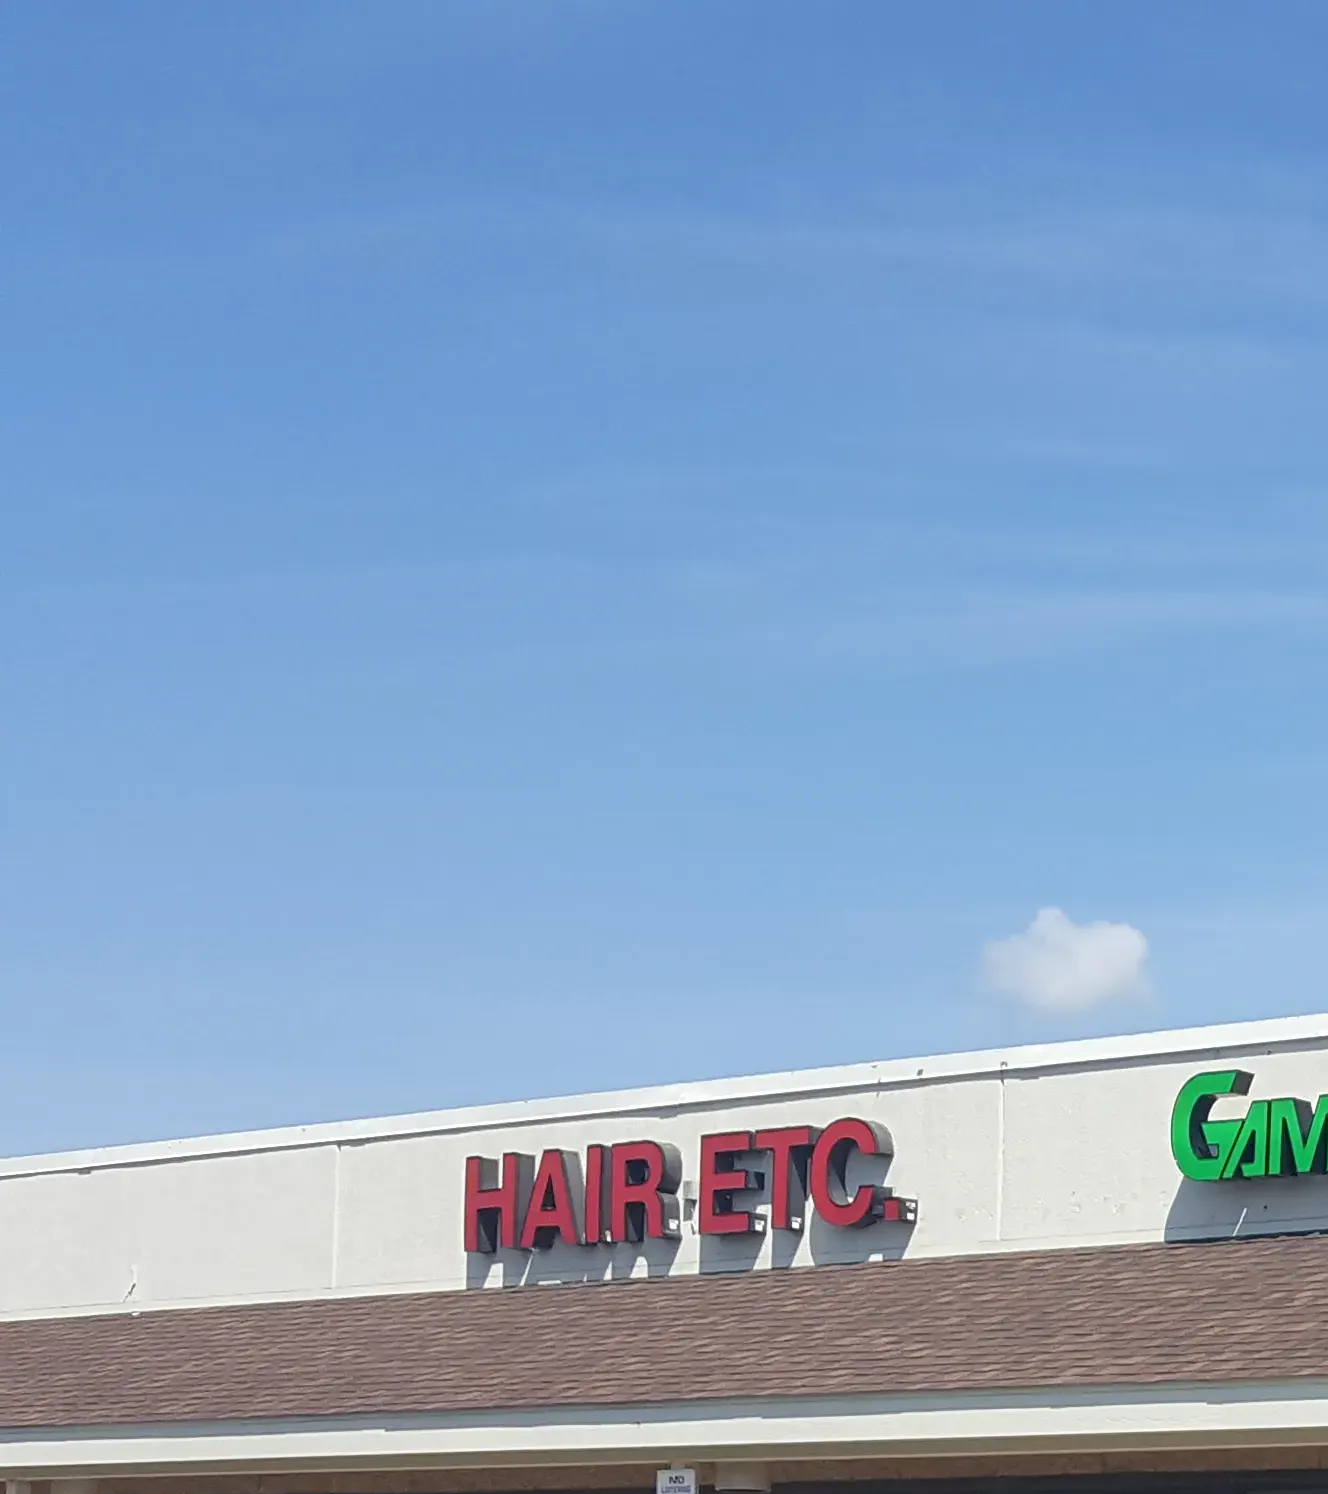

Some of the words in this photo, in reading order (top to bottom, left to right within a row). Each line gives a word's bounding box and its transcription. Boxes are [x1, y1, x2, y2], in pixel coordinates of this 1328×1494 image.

[464, 1139, 681, 1253] HAIR
[699, 1117, 917, 1235] ETC.
[668, 1475, 685, 1485] NO
